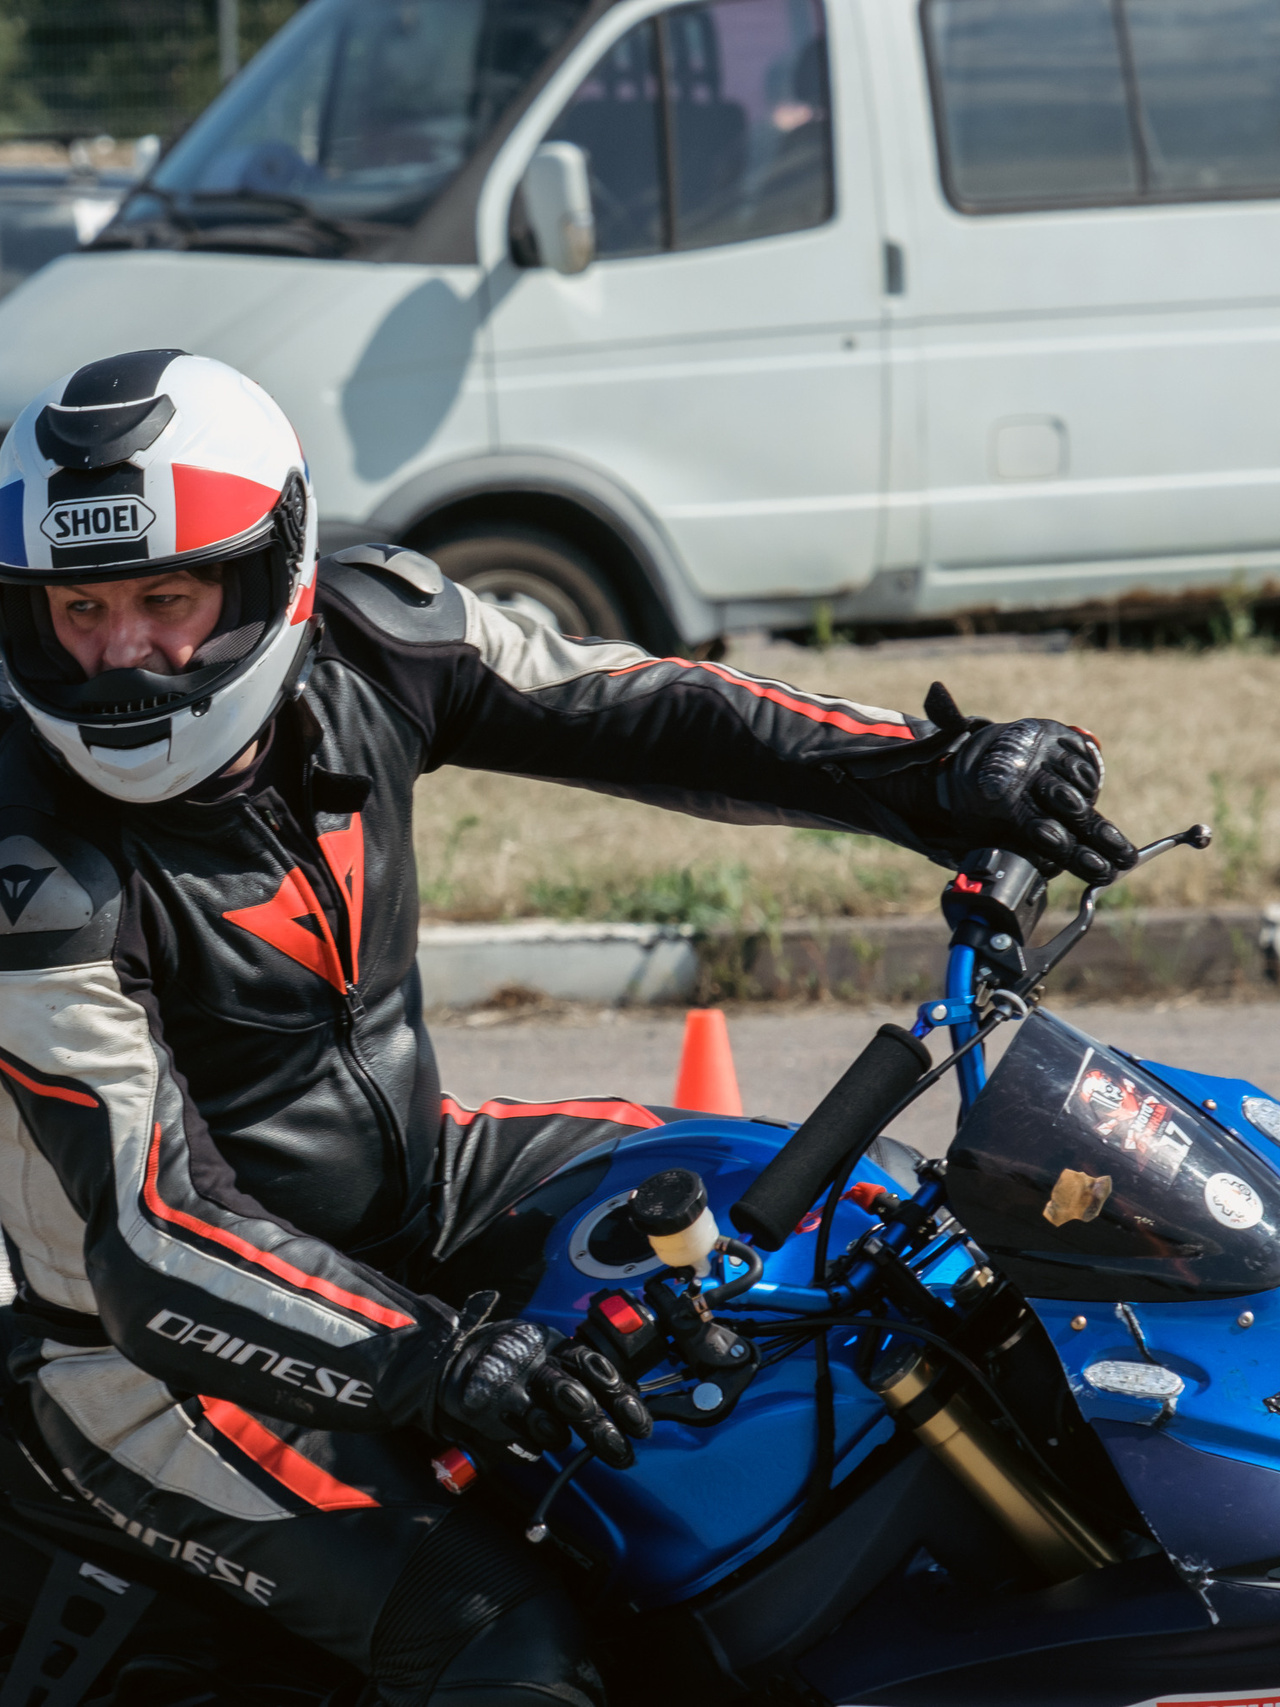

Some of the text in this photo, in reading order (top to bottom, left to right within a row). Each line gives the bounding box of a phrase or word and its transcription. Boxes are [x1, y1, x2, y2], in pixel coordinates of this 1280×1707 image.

[54, 504, 139, 539] SHOEI
[1158, 1120, 1194, 1158] 17
[146, 1308, 375, 1408] DAINESE
